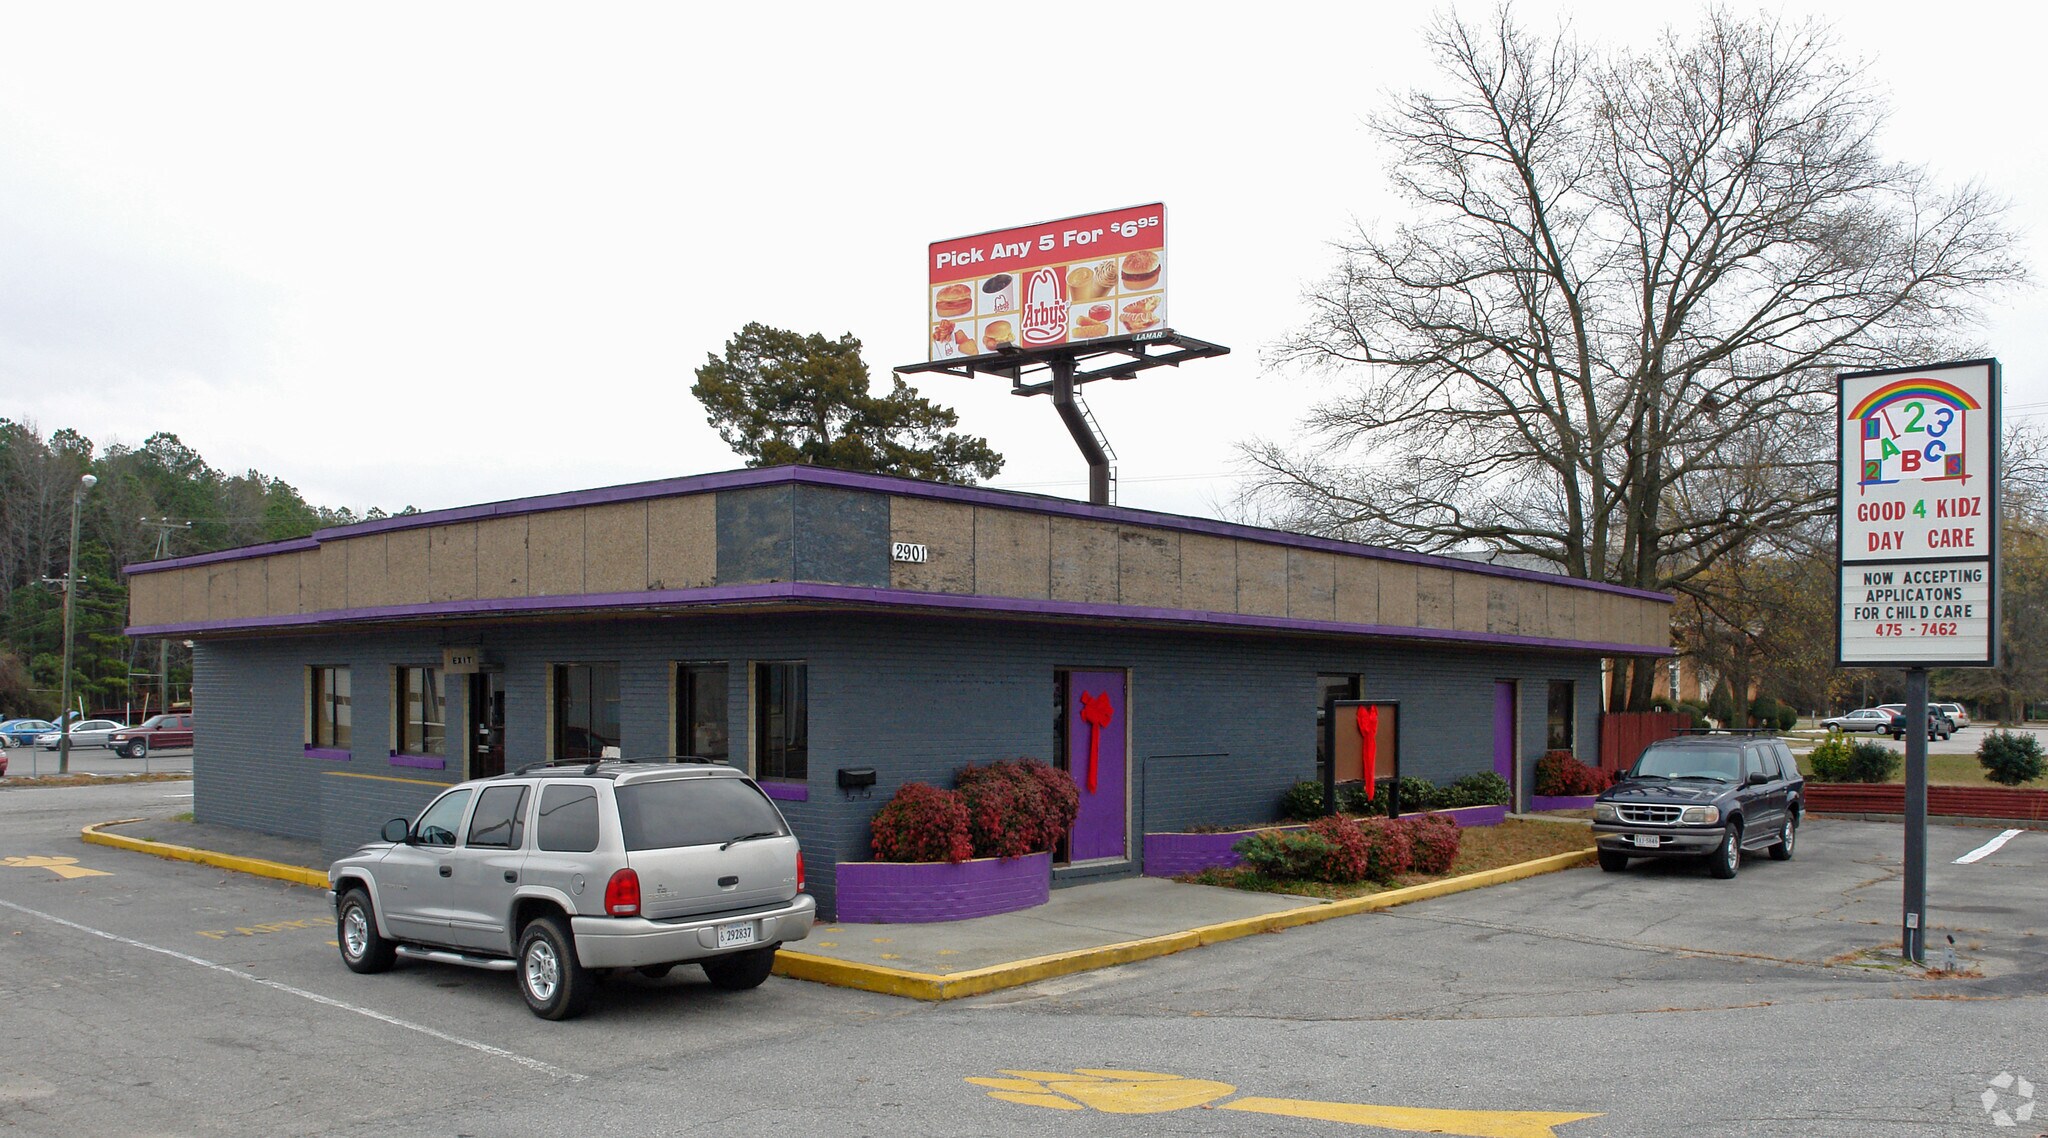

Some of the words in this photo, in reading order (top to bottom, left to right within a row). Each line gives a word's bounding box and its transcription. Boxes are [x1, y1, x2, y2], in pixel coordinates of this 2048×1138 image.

[936, 247, 985, 269] Pick
[990, 240, 1032, 259] Any
[1038, 234, 1055, 251] 5
[1063, 228, 1103, 248] For
[1023, 301, 1067, 330] Arby's
[1136, 331, 1163, 341] LAMAR
[1857, 501, 1906, 522] GOOD
[1912, 499, 1926, 519] 4
[1937, 496, 1981, 518] KIDZ
[1868, 530, 1904, 552] DAY
[1927, 527, 1975, 549] CARE
[896, 543, 925, 562] 2901
[1863, 572, 1893, 586] NOW
[1903, 569, 1982, 584] ACCEPTING
[1866, 587, 1962, 602] APPLICATONS
[1854, 606, 1880, 620] FOR
[1886, 604, 1929, 619] CHILD
[1934, 604, 1972, 618] CARE
[1875, 623, 1902, 637] 475
[1921, 622, 1957, 636] 7462
[452, 656, 472, 665] EXIT
[727, 927, 752, 941] 292837
